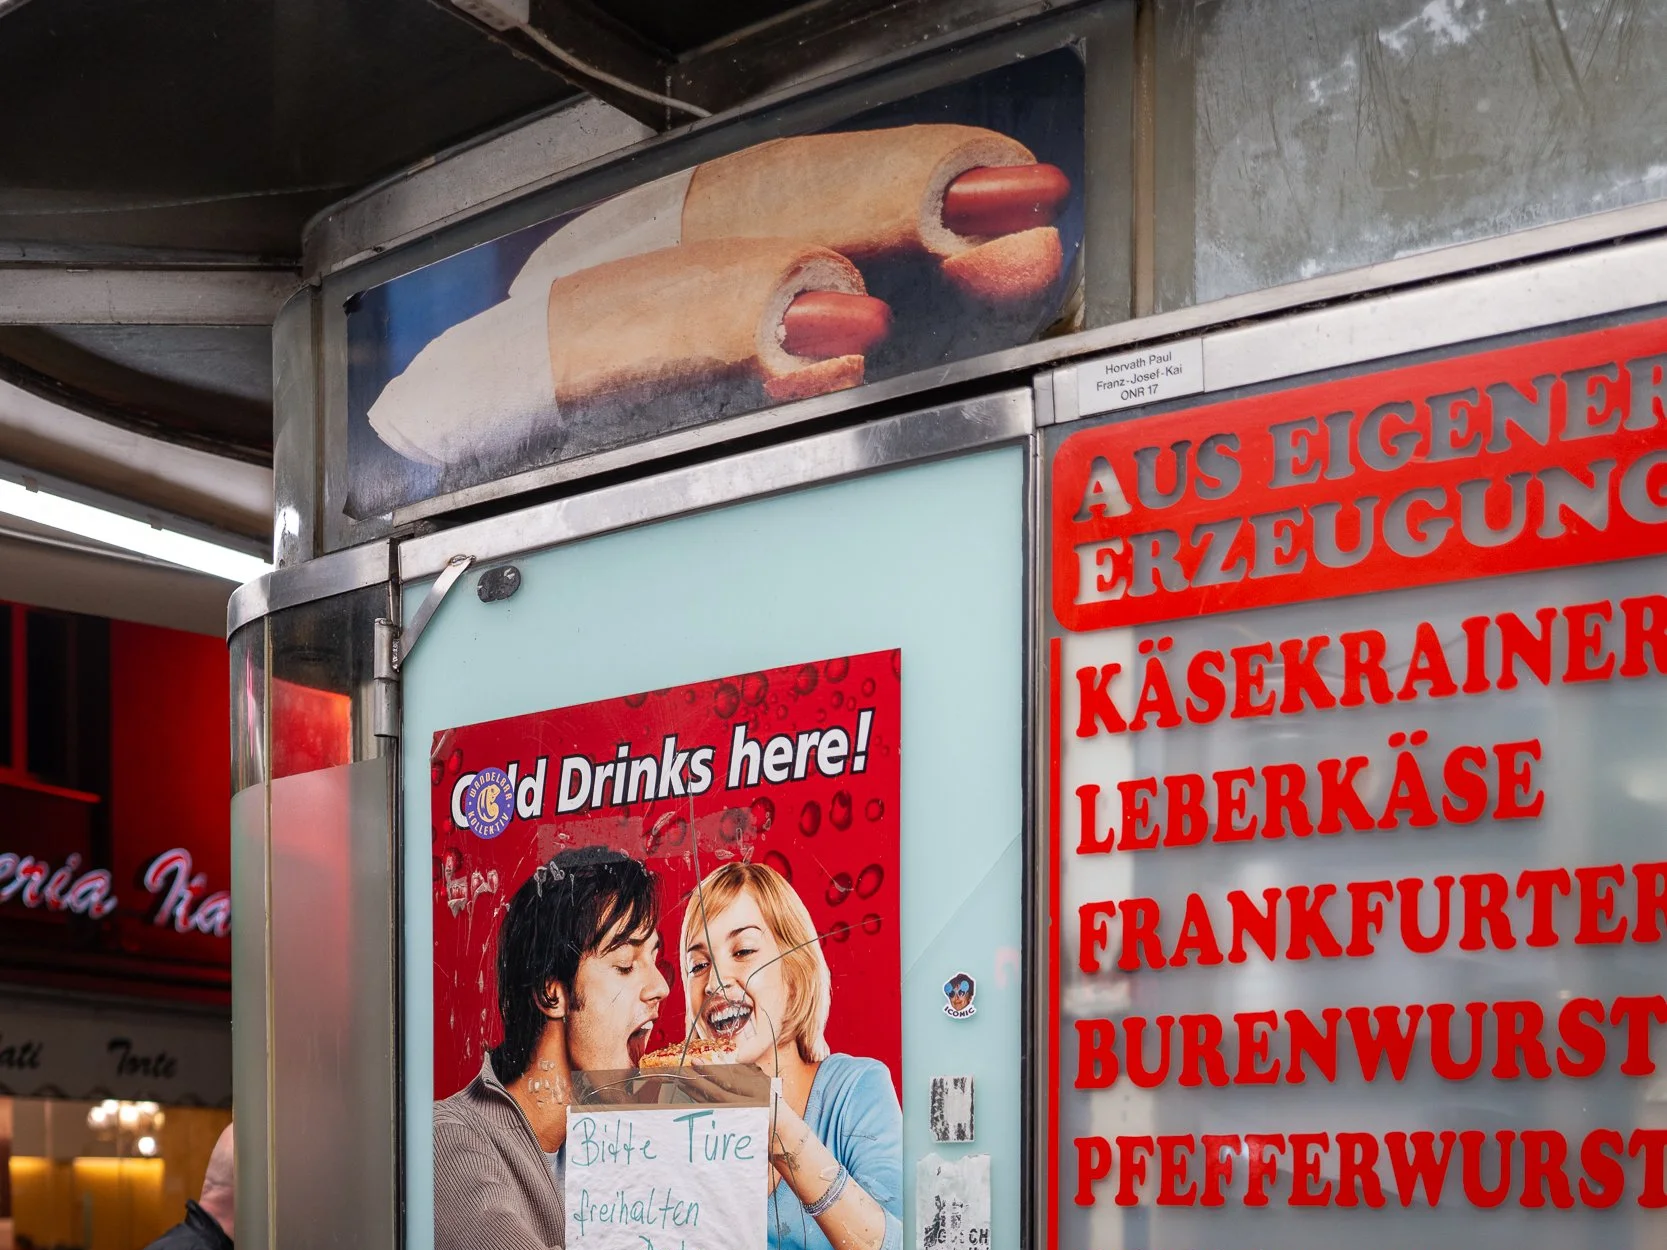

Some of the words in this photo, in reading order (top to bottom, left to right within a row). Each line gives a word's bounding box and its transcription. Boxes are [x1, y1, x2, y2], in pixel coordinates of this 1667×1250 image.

[1105, 357, 1146, 375] Horvath
[1149, 352, 1172, 366] Paul
[1120, 388, 1145, 401] ONR
[1148, 384, 1159, 395] 17
[1073, 433, 1241, 523] AUS
[1269, 353, 1667, 491] EIGENER
[1073, 448, 1667, 605] ERZEUGUNG
[1075, 595, 1667, 738] KÄSEKRAINER
[470, 772, 513, 800] WANDELBAR
[556, 737, 714, 814] Drinks
[728, 707, 876, 789] here!
[1075, 730, 1545, 855] LEBERKÄSE
[468, 811, 509, 836] KOLLEKTIV
[1077, 862, 1667, 974] FRANKFURTER
[944, 1006, 975, 1018] ICONIC
[1074, 995, 1667, 1090] BURENWURST
[107, 1037, 178, 1078] Torte
[571, 1117, 657, 1167] Bitte
[1074, 1128, 1667, 1207] PFEFFERWURST
[573, 1188, 699, 1237] freihalten
